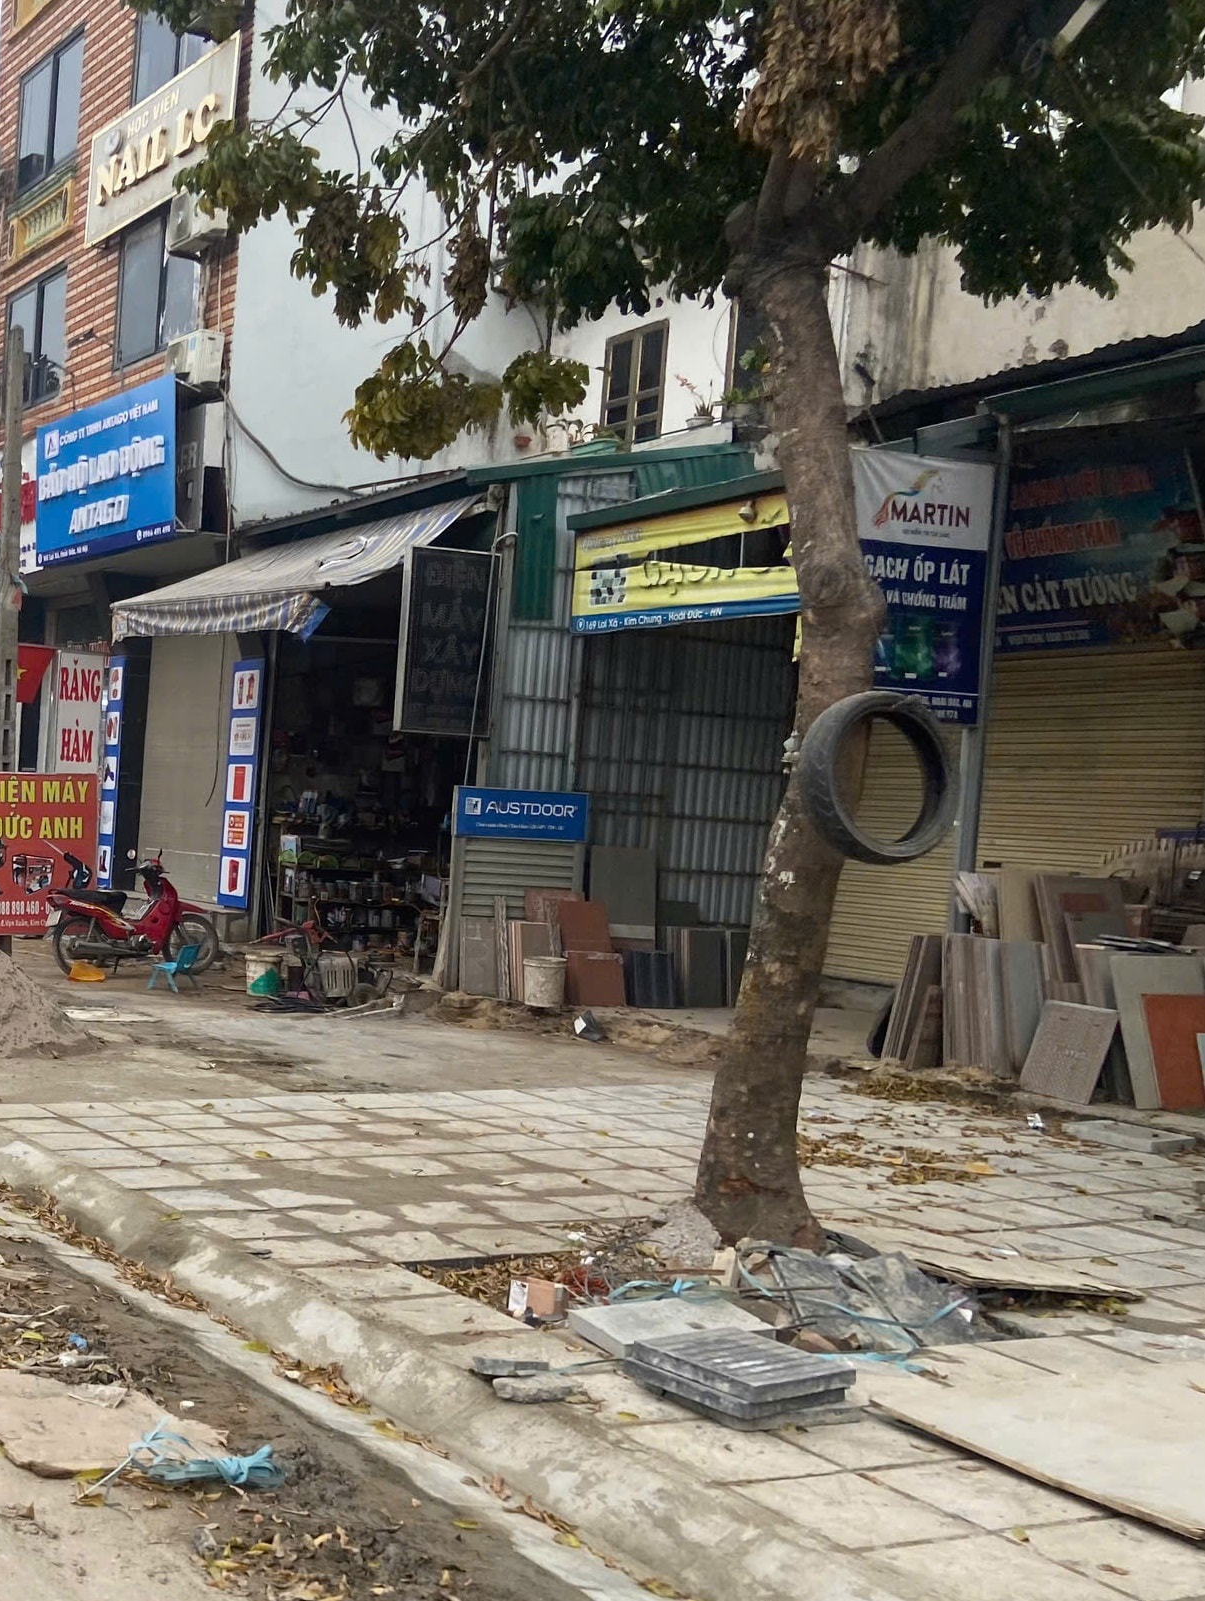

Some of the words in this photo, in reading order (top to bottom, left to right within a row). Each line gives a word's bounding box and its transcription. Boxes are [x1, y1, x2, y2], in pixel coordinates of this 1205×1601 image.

[95, 125, 167, 206] NAIL
[173, 93, 217, 157] LC
[142, 398, 159, 415] NAM
[68, 494, 130, 535] ANTAGO
[891, 500, 970, 528] MARTIN
[864, 554, 910, 582] GẠCH
[913, 552, 936, 583] ỐP
[939, 558, 971, 586] LÁT
[902, 588, 936, 608] CHỐNG
[938, 591, 968, 611] THẤM
[586, 621, 597, 630] 169
[597, 620, 607, 629] Lai
[608, 617, 618, 627] Xá
[624, 616, 637, 626] Kim
[638, 615, 662, 626] Chung
[709, 607, 723, 617] HN
[59, 657, 101, 703] RĂNG
[59, 718, 94, 763] HÀM
[42, 775, 89, 803] MÁY
[485, 801, 575, 818] AUSTDOOR
[38, 816, 84, 839] ANH
[11, 901, 25, 915] 898
[26, 901, 40, 915] 460
